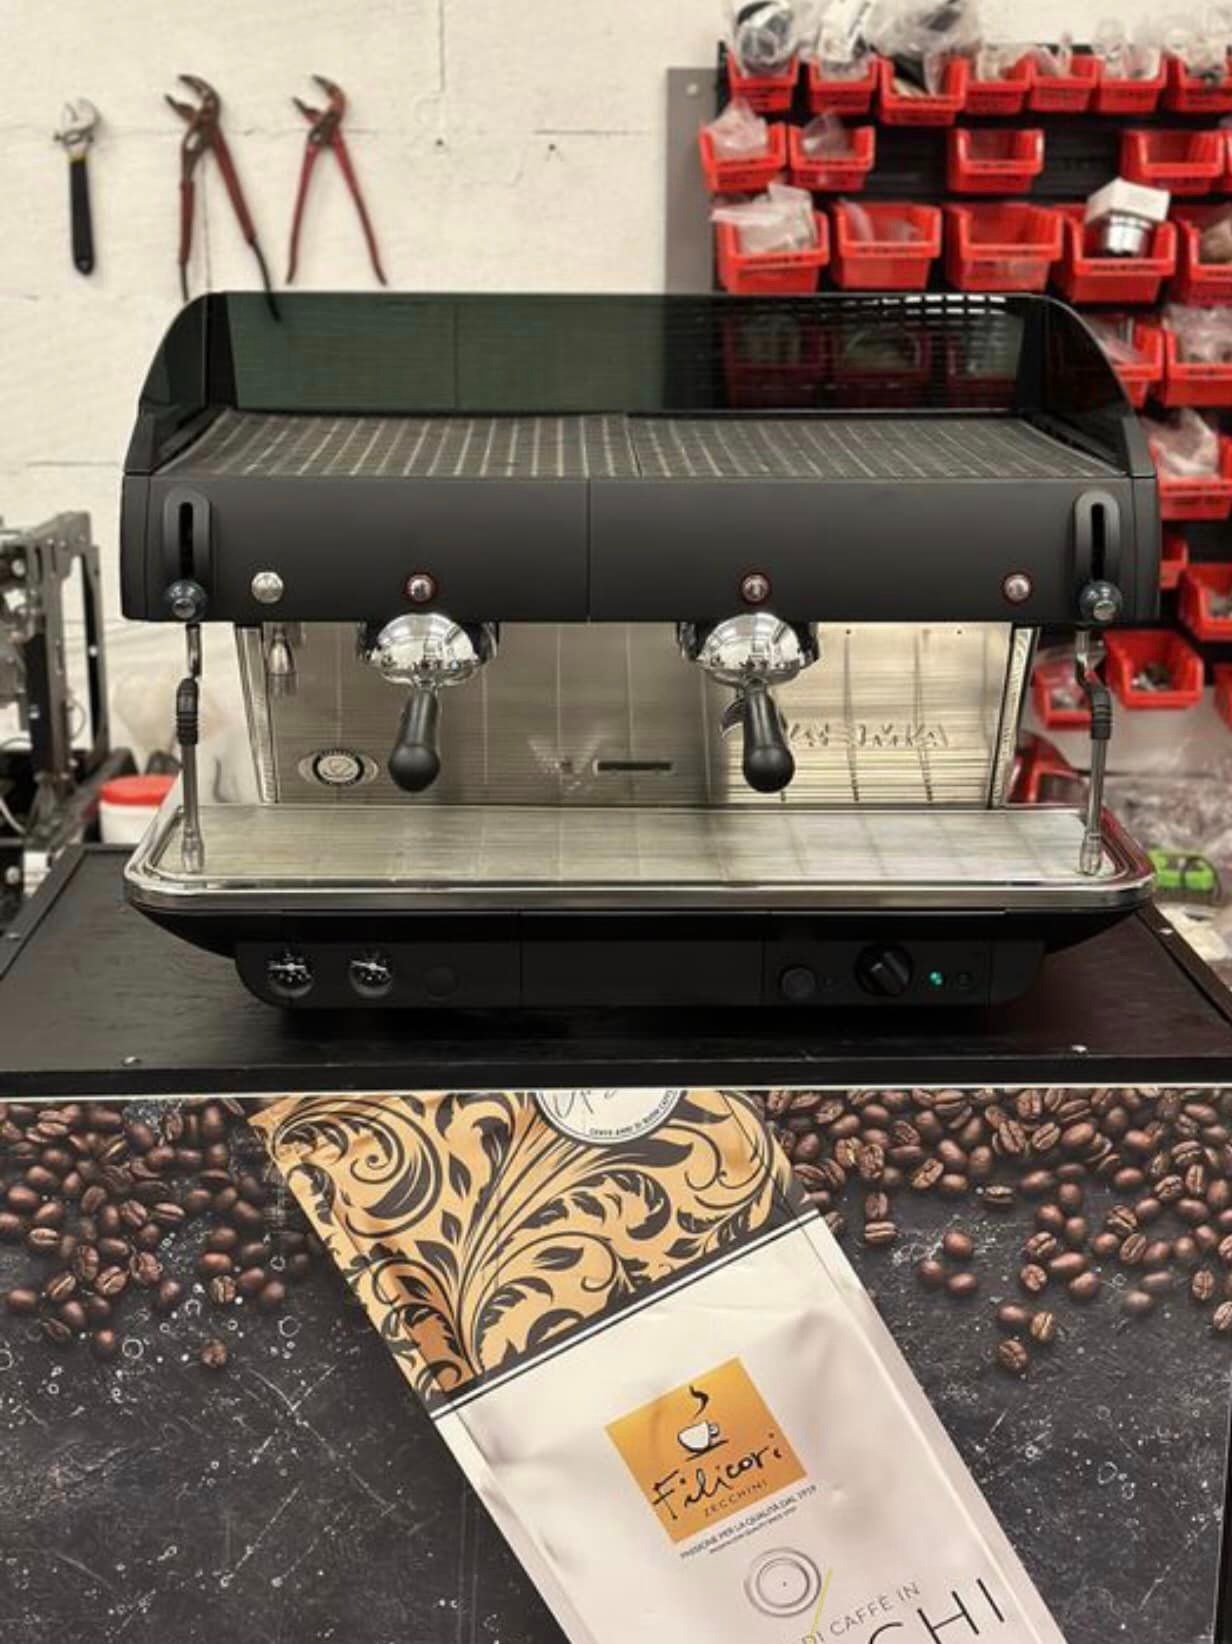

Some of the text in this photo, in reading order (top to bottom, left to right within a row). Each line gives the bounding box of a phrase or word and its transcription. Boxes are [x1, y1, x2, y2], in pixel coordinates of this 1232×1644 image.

[652, 1432, 782, 1520] Filicori
[704, 1479, 768, 1518] ZECCHINI
[895, 1580, 920, 1601] IN
